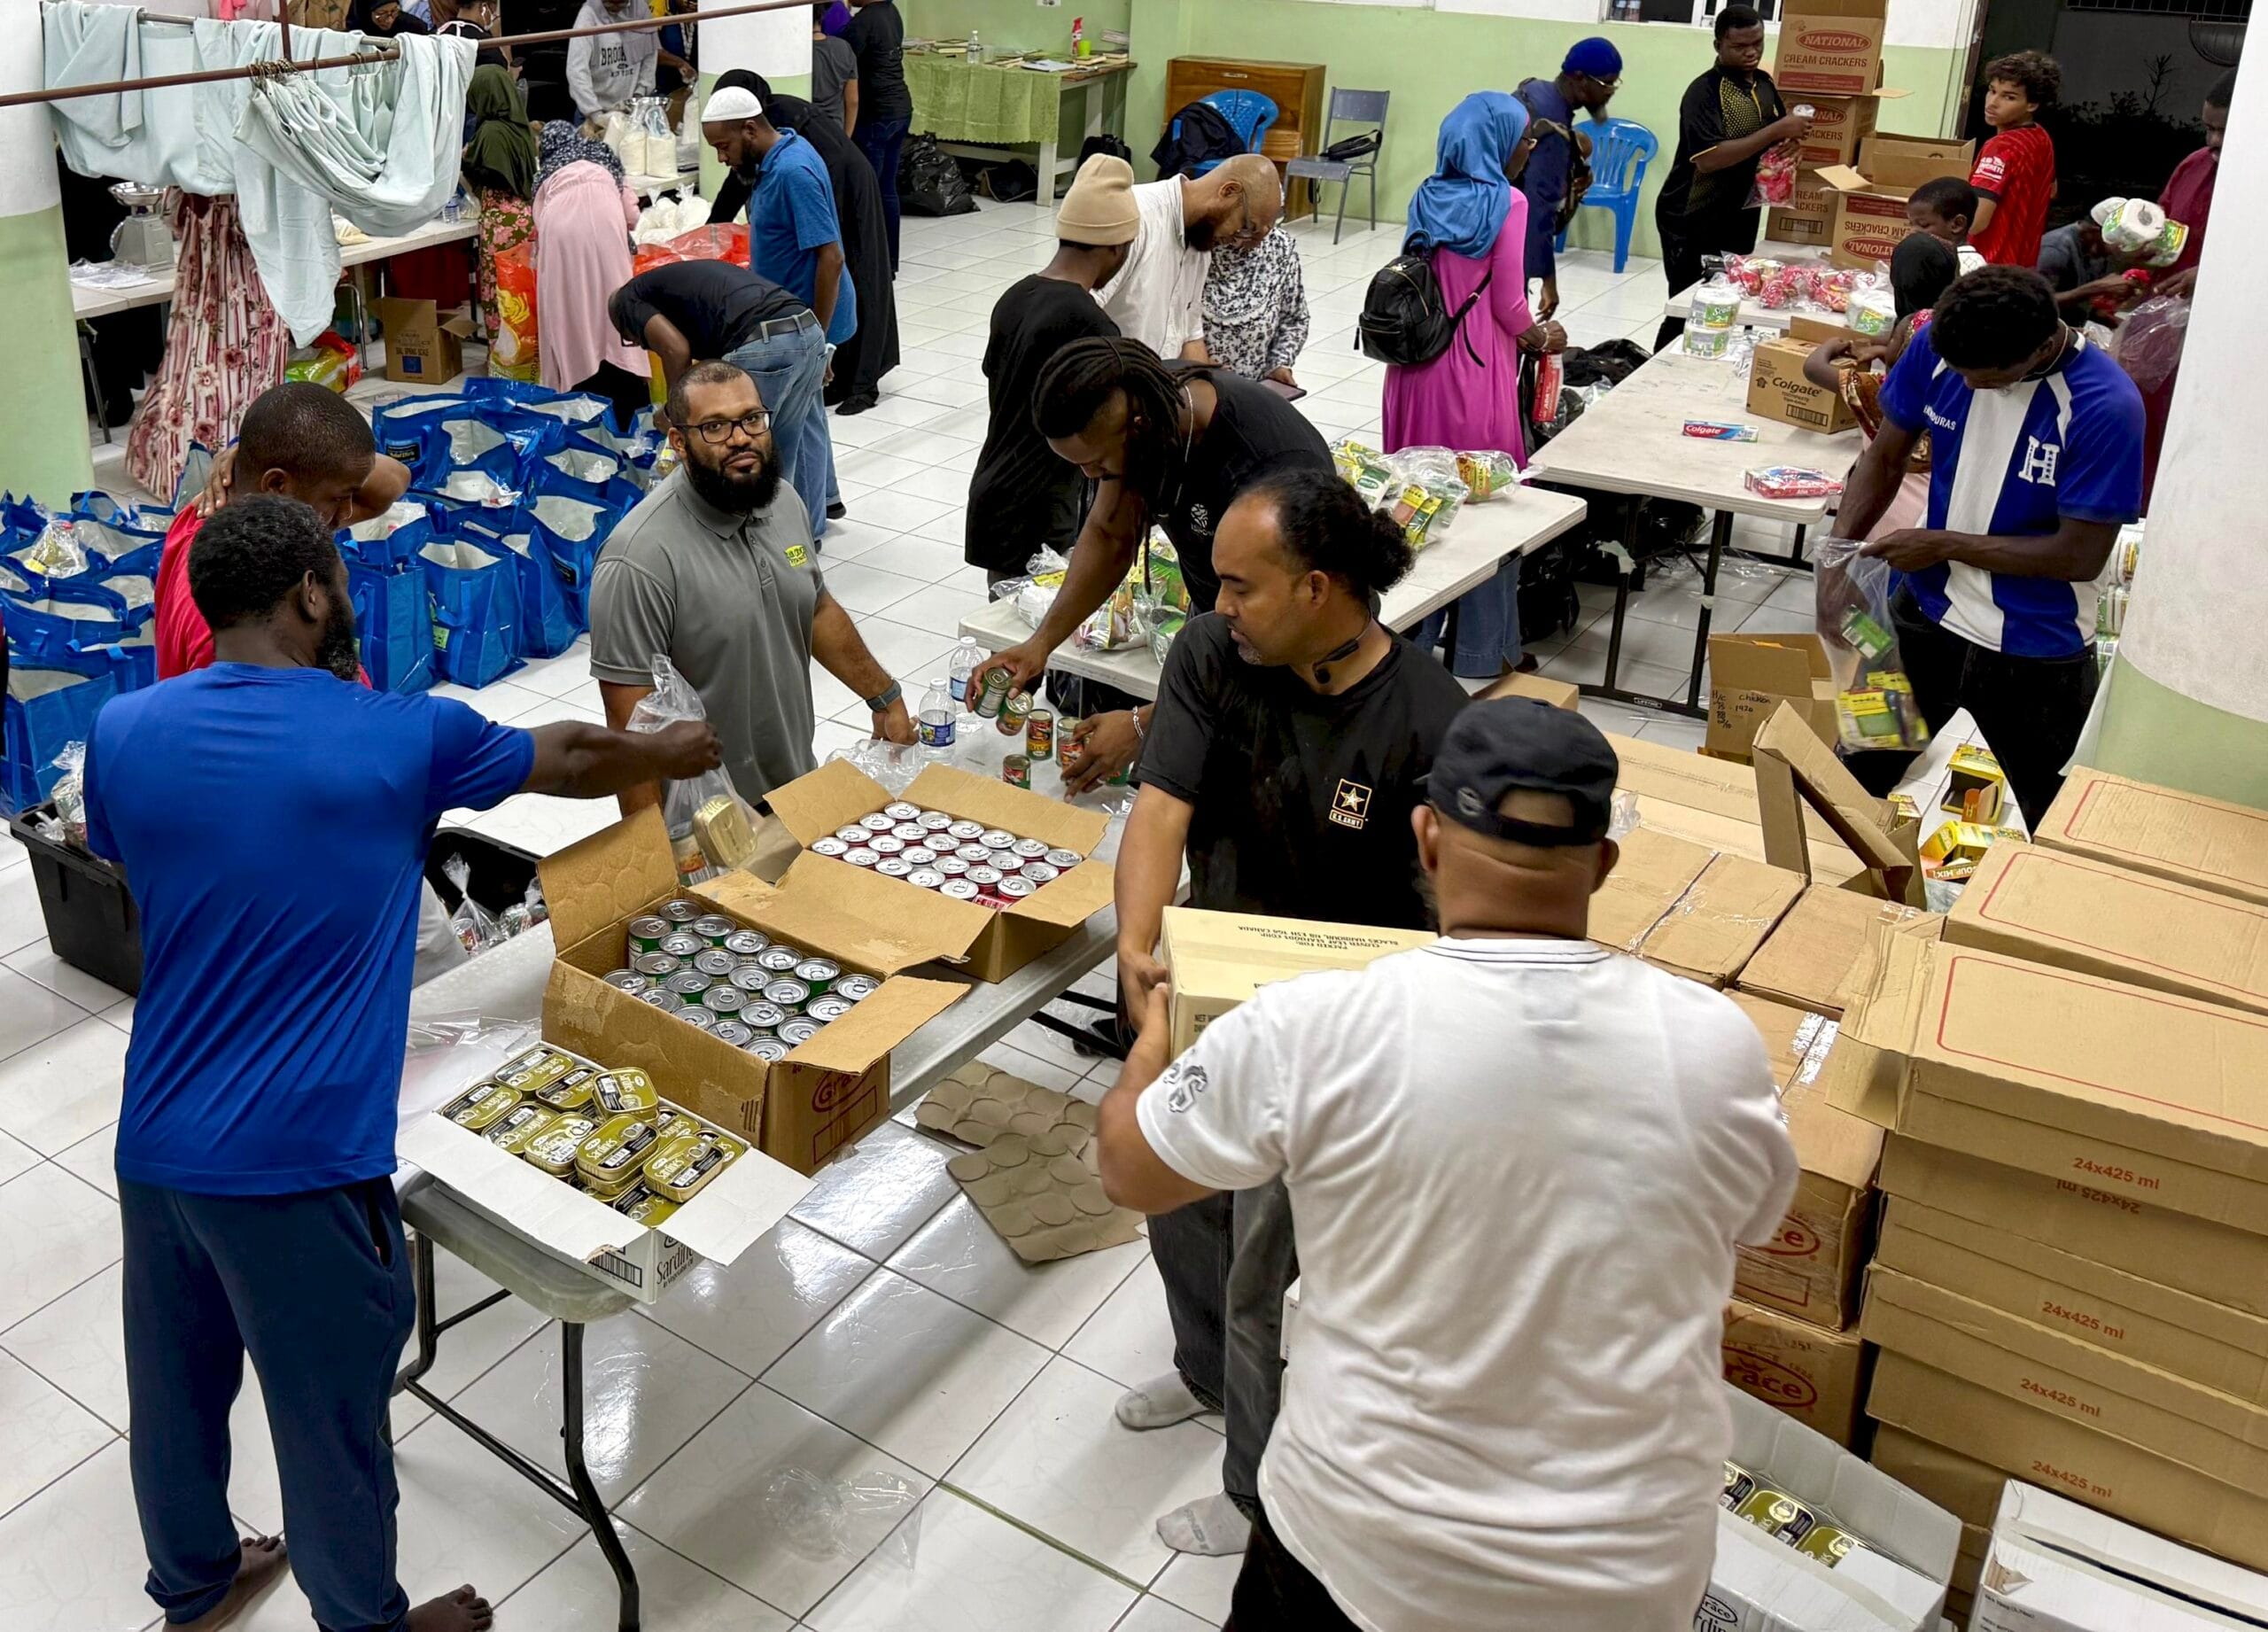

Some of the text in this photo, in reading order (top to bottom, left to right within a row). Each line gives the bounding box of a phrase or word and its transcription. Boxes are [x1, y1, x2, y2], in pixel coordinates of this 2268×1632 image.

[1805, 35, 1866, 48] NATIONAL
[1783, 53, 1868, 67] CREAM CRACKERS
[1796, 190, 1823, 200] REAM
[1845, 221, 1890, 235] CRACKERS
[1773, 377, 1819, 398] Colgate
[1685, 425, 1720, 434] Colgate
[2073, 1157, 2160, 1189] 24x425 ml
[2081, 1186, 2141, 1214] 24x425
[2041, 1302, 2125, 1341] 24x425 ml
[1725, 1364, 1803, 1399] race
[2020, 1378, 2101, 1418] 24x425 ml
[2031, 1460, 2112, 1498] 24x425 ml
[1704, 1600, 1732, 1620] race
